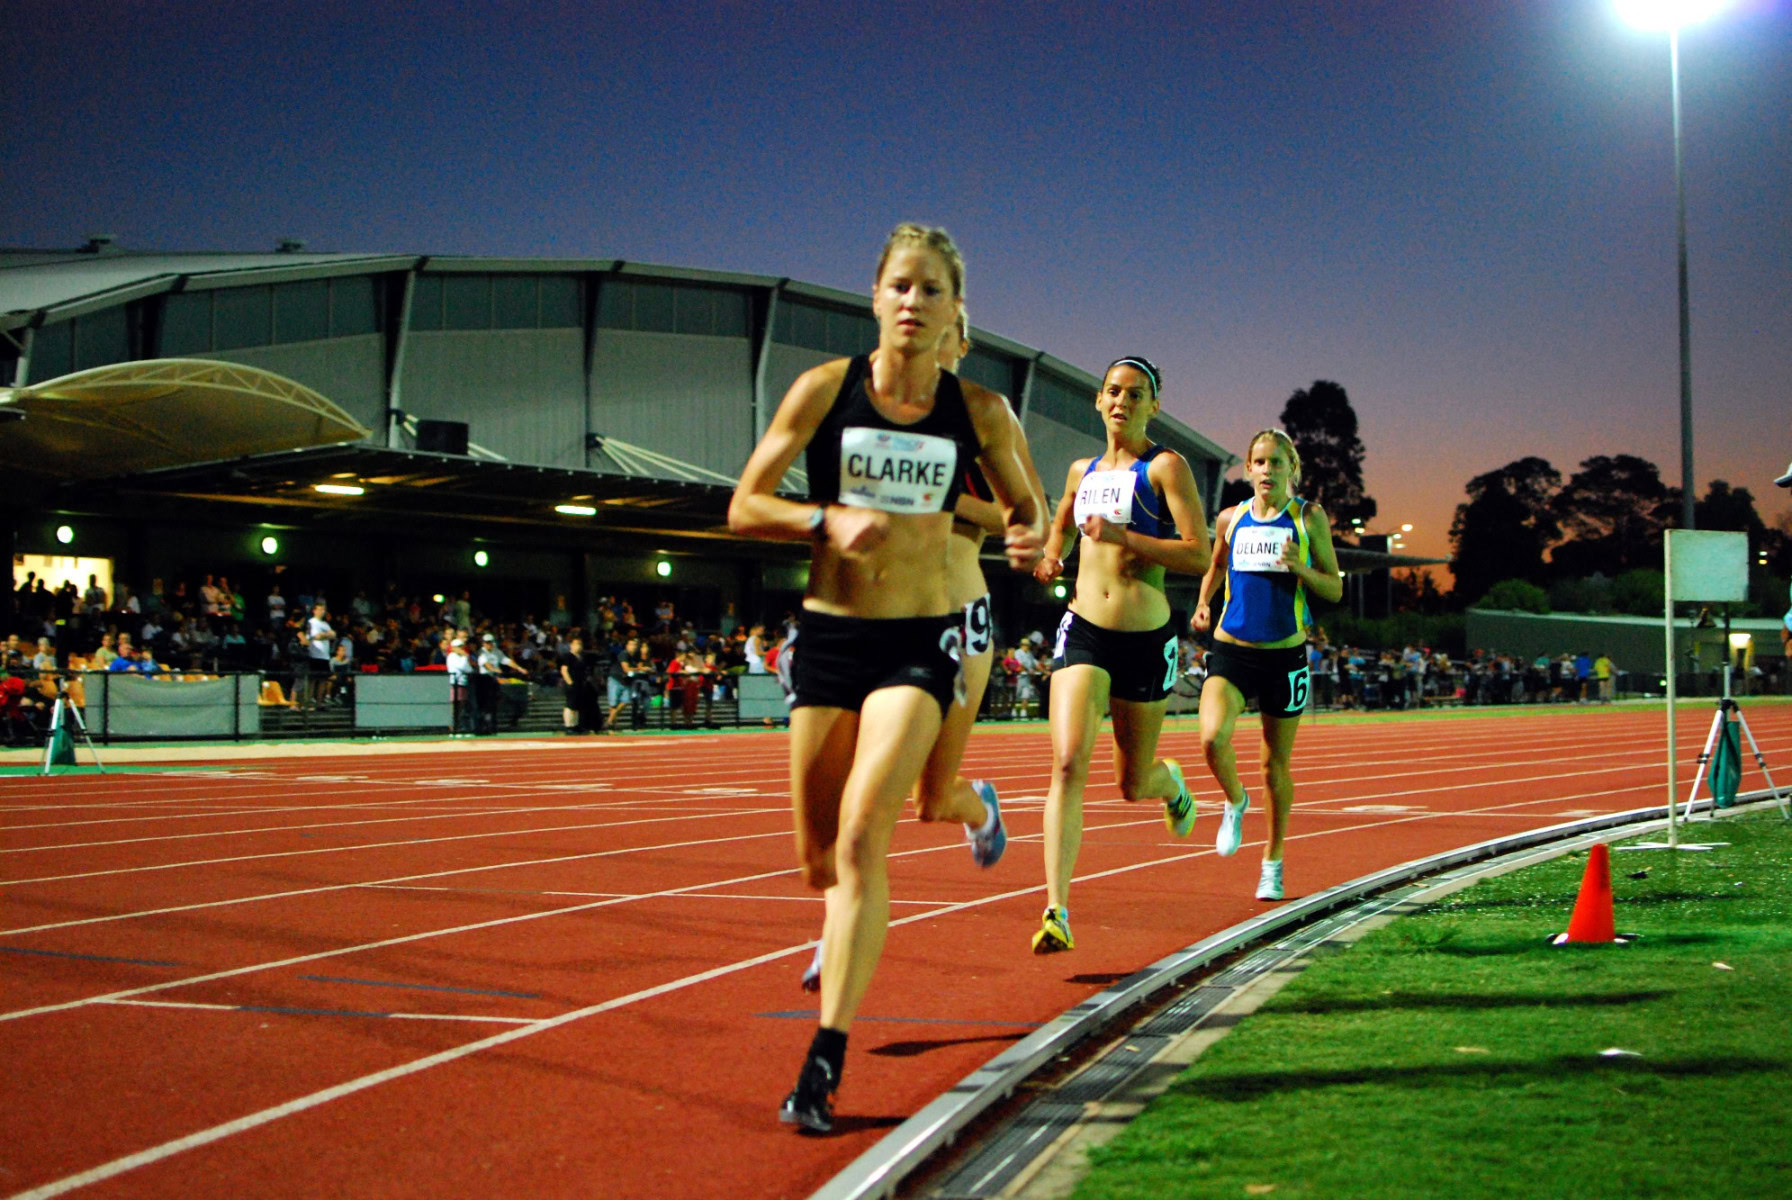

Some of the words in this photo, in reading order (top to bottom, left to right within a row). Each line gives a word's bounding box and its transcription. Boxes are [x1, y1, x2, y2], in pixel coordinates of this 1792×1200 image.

[848, 454, 946, 487] CLARKE
[1237, 542, 1282, 555] DELANE
[970, 597, 990, 653] 9
[1293, 671, 1308, 707] 6
